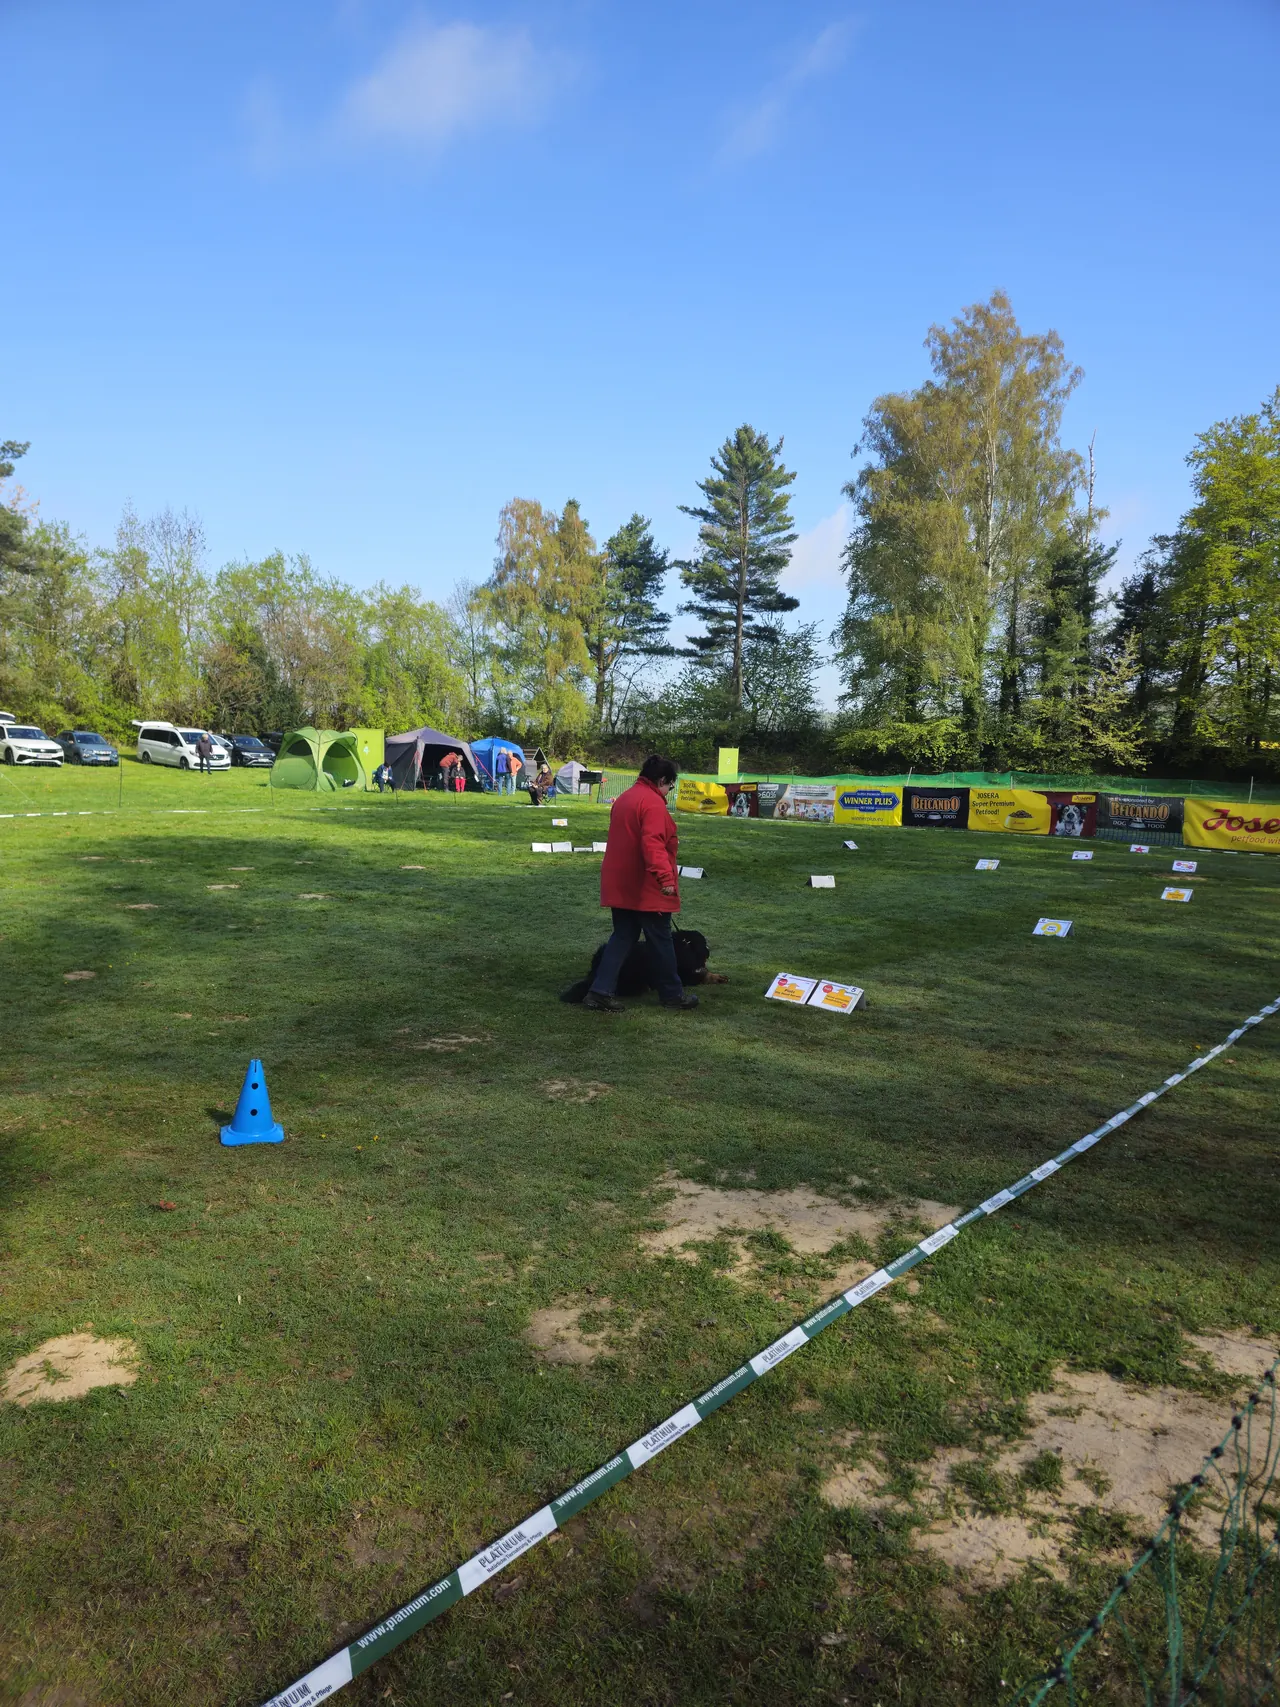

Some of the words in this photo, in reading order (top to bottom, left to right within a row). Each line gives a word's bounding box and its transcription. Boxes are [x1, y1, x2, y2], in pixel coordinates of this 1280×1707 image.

[874, 797, 893, 805] PLUS
[911, 795, 960, 811] BELCANDO
[972, 801, 988, 809] Super
[1109, 801, 1170, 820] BELCANDO
[1230, 835, 1266, 844] petfood
[761, 1341, 790, 1362] PLATINUM
[697, 1366, 748, 1404] www.platinum.com
[641, 1421, 678, 1450] PLATINUM
[555, 1456, 623, 1507] www.platinum.com
[478, 1531, 527, 1568] PLATINUM
[357, 1579, 451, 1648] www.platinum.com
[315, 1685, 333, 1699] Pflege
